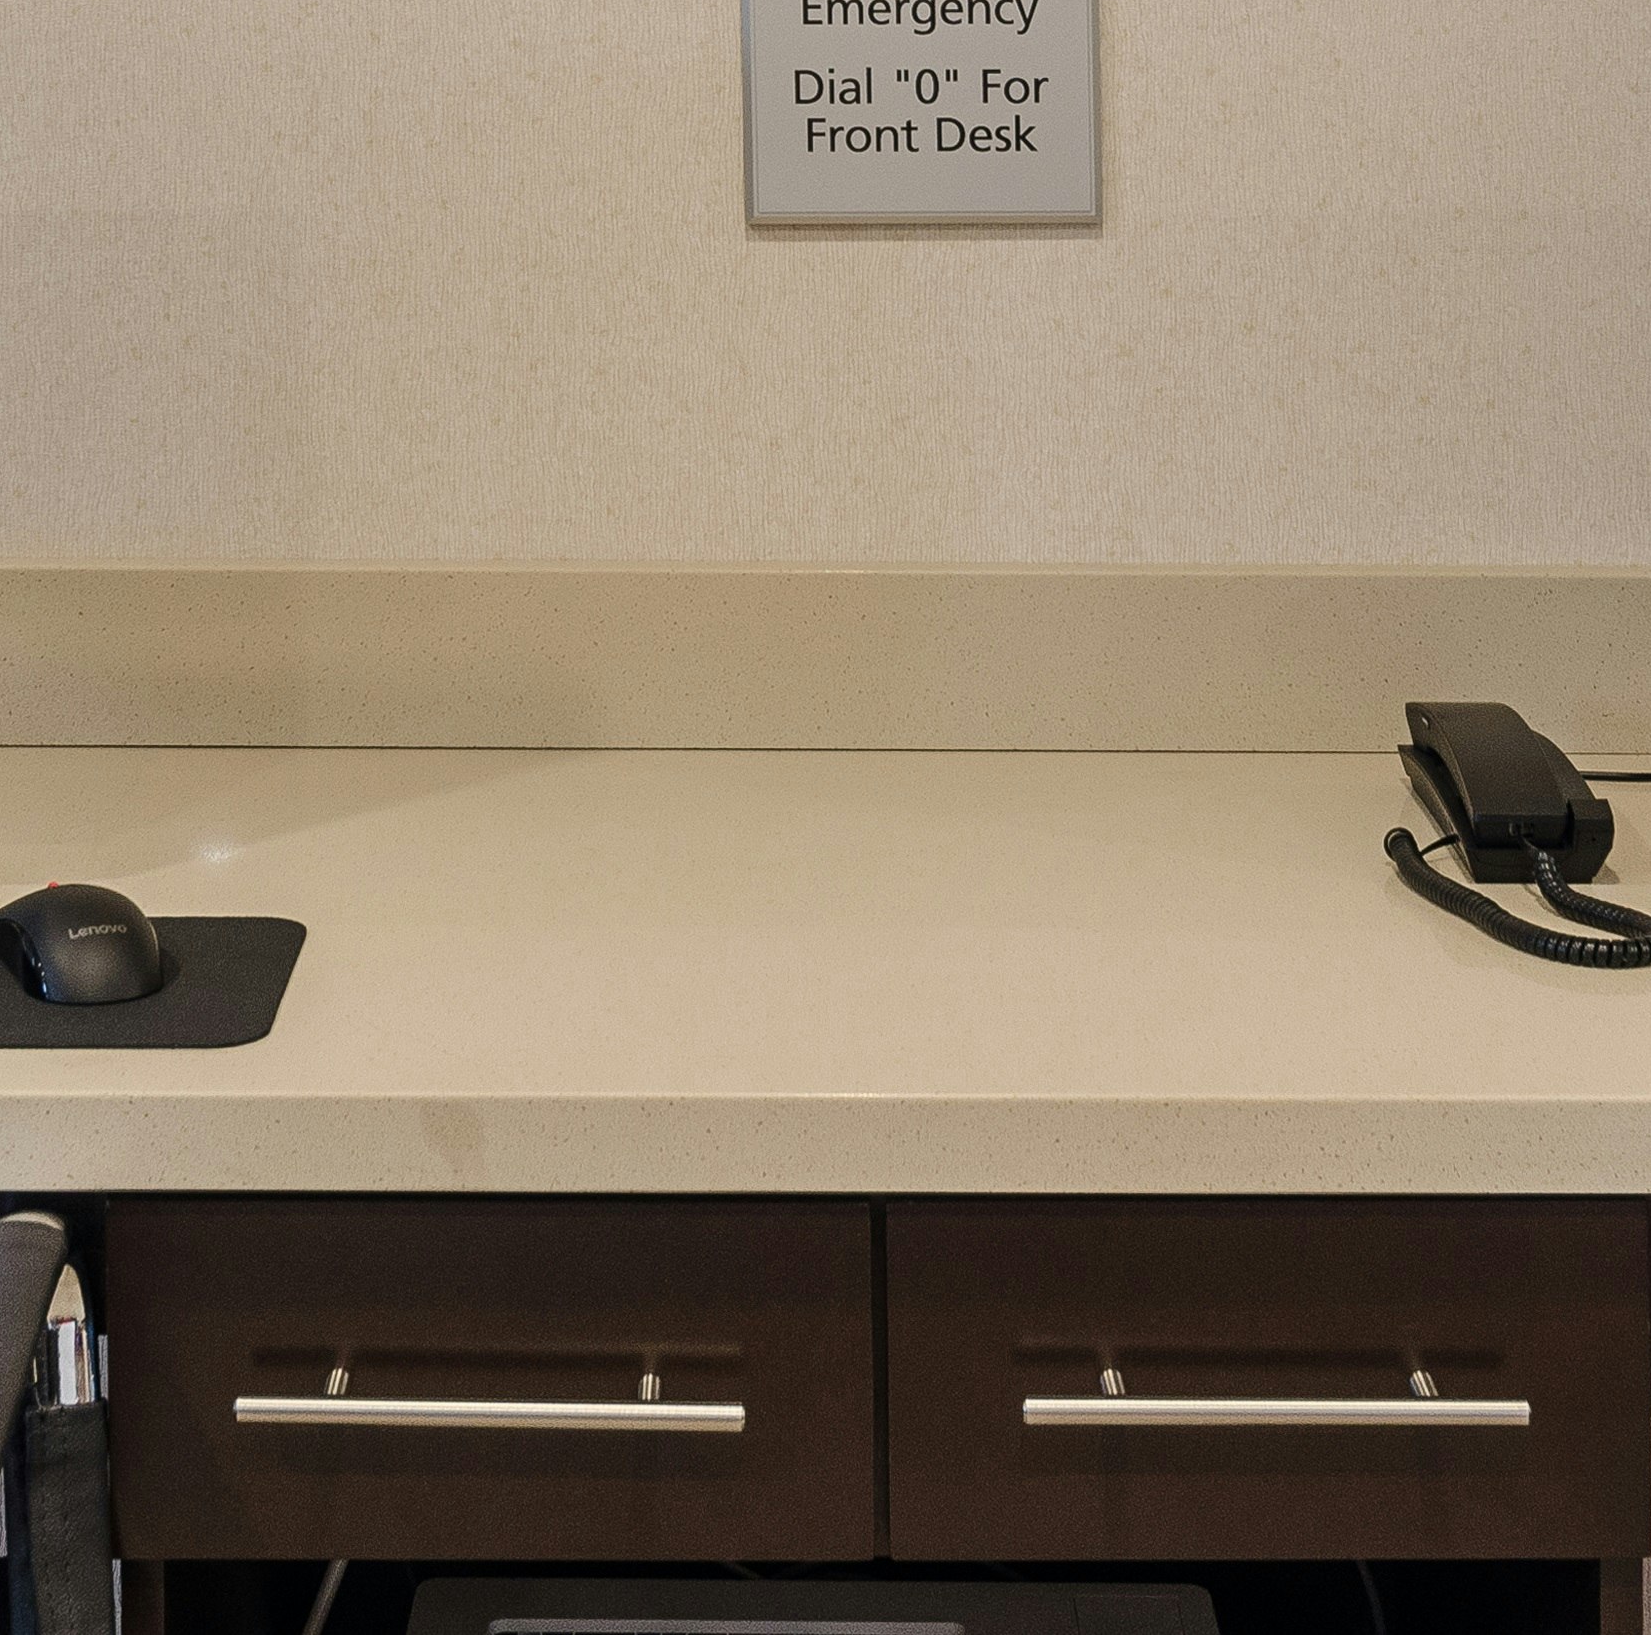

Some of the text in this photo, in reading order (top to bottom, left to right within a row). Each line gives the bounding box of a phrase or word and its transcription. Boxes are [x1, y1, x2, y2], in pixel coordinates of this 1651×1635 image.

[793, 67, 1049, 105] Dial "0" For
[806, 115, 1038, 153] Front Desk
[68, 923, 128, 940] Lenovo
